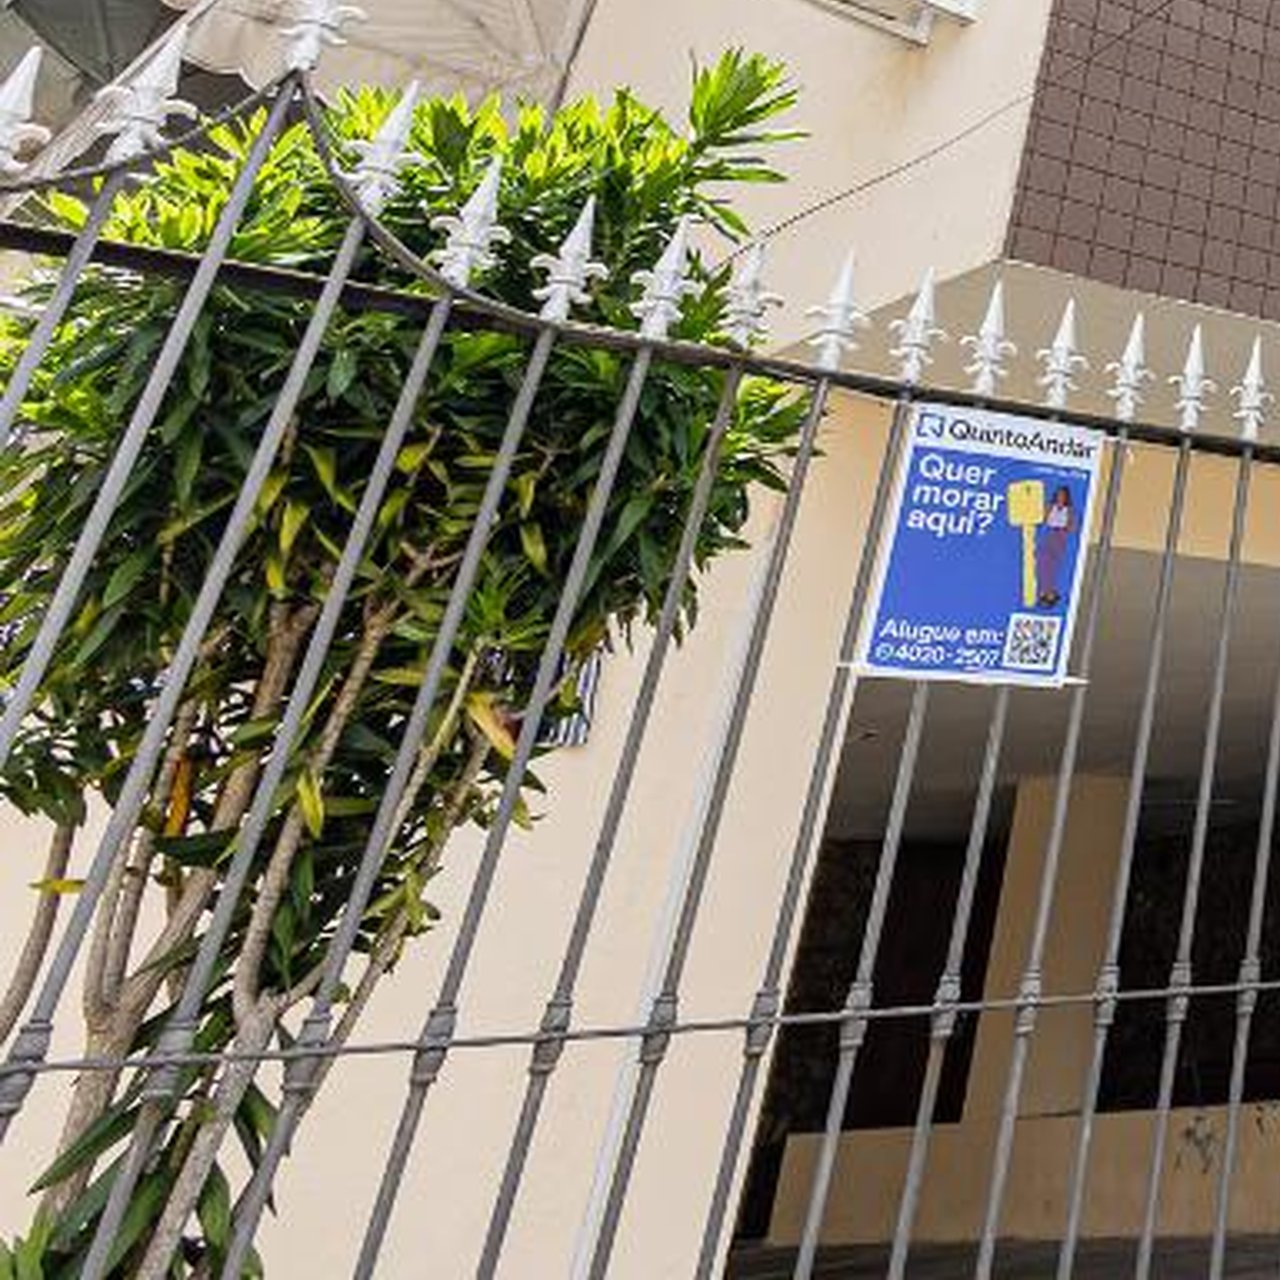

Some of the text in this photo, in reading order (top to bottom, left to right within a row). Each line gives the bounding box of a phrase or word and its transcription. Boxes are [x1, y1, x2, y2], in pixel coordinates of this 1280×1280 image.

[949, 419, 1096, 459] QuintoAndar
[919, 452, 997, 485] Quer
[913, 483, 1005, 512] morar
[906, 509, 994, 538] aqui?
[880, 618, 1004, 644] Alugue em:
